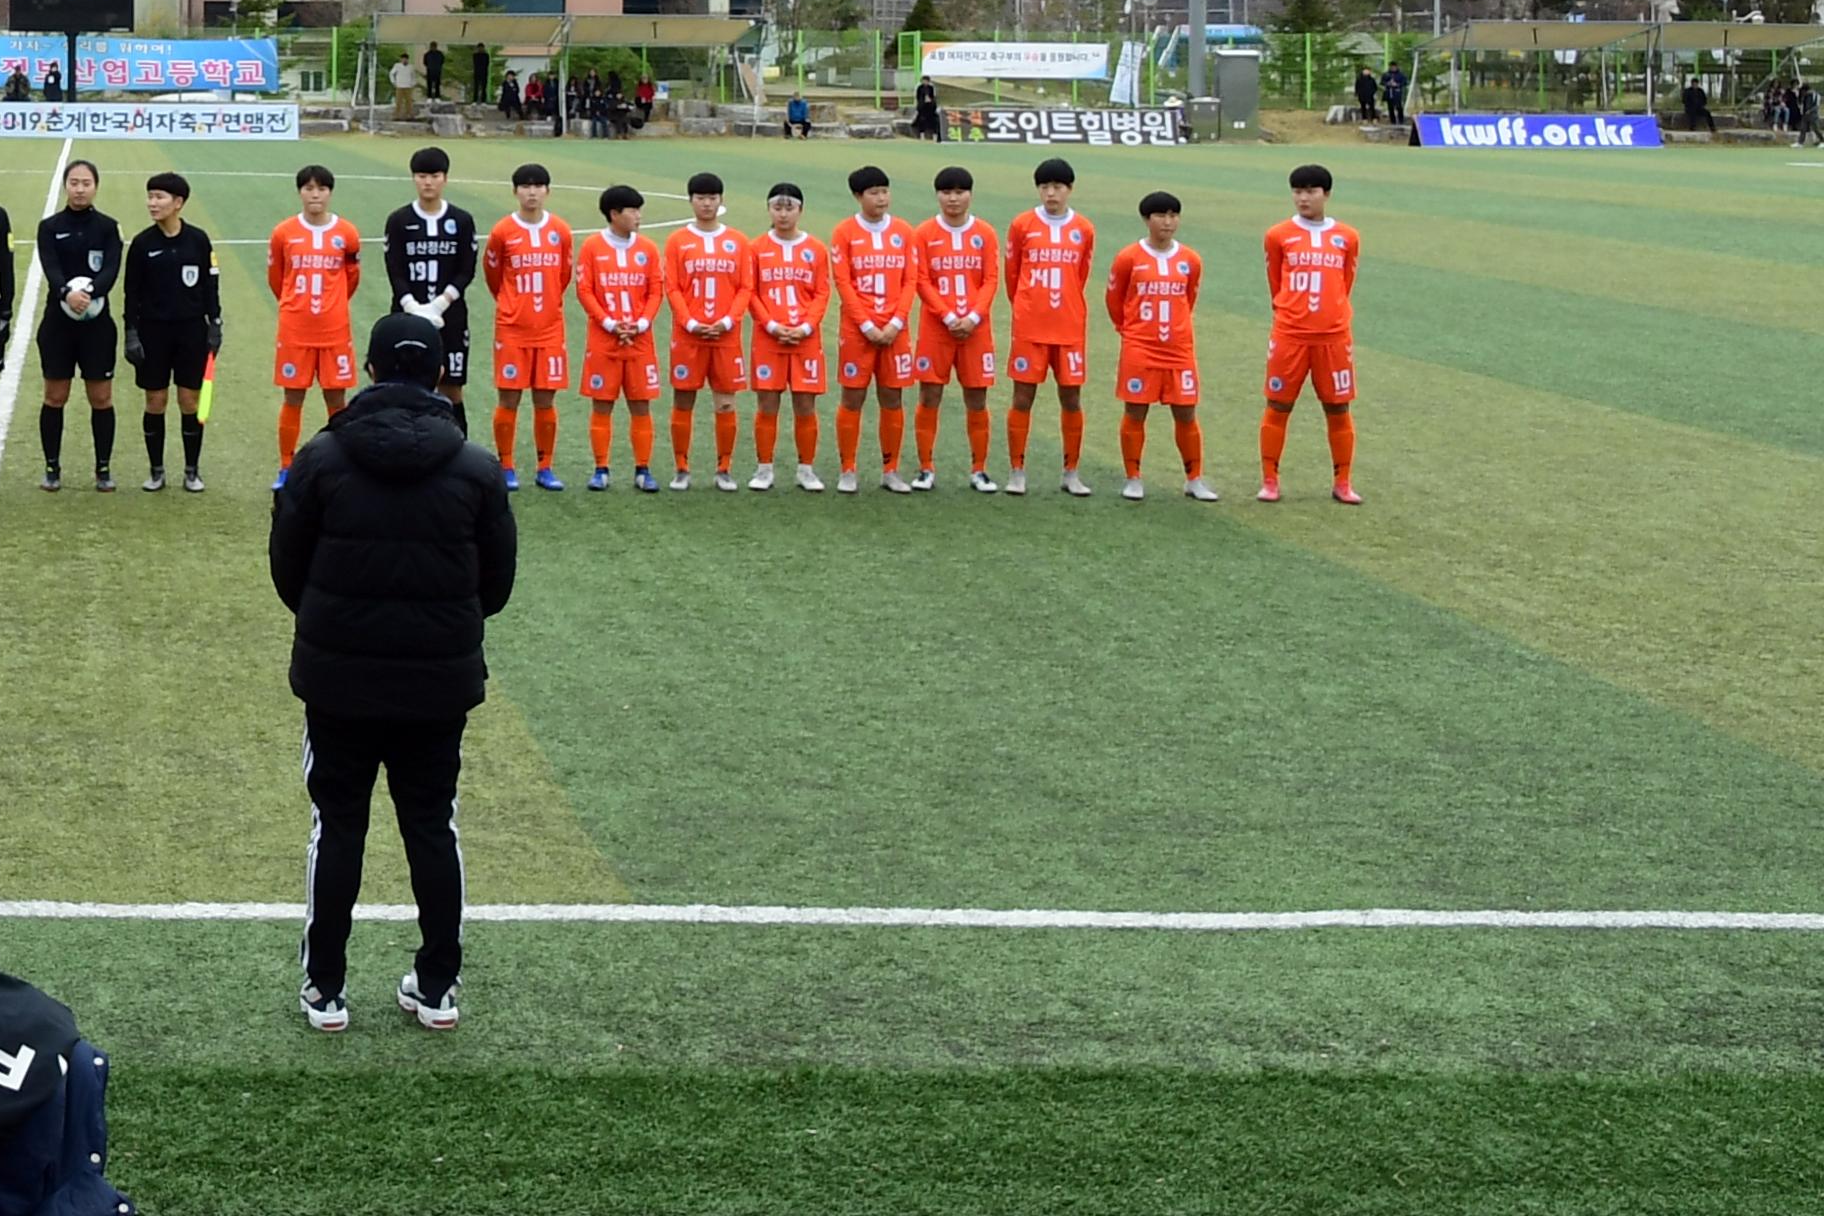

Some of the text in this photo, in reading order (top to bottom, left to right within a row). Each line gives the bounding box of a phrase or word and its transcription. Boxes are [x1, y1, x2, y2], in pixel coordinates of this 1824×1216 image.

[1439, 117, 1634, 146] kwff.or.kr
[408, 261, 426, 282] 19
[1289, 271, 1308, 292] 10
[516, 273, 531, 294] 11
[604, 292, 616, 313] 5
[1140, 301, 1153, 321] 6
[448, 352, 464, 372] 19
[548, 356, 563, 377] 11
[804, 359, 818, 378] 4
[895, 353, 912, 373] 12
[646, 364, 658, 384] 5
[1181, 370, 1193, 390] 6
[1332, 369, 1351, 391] 10
